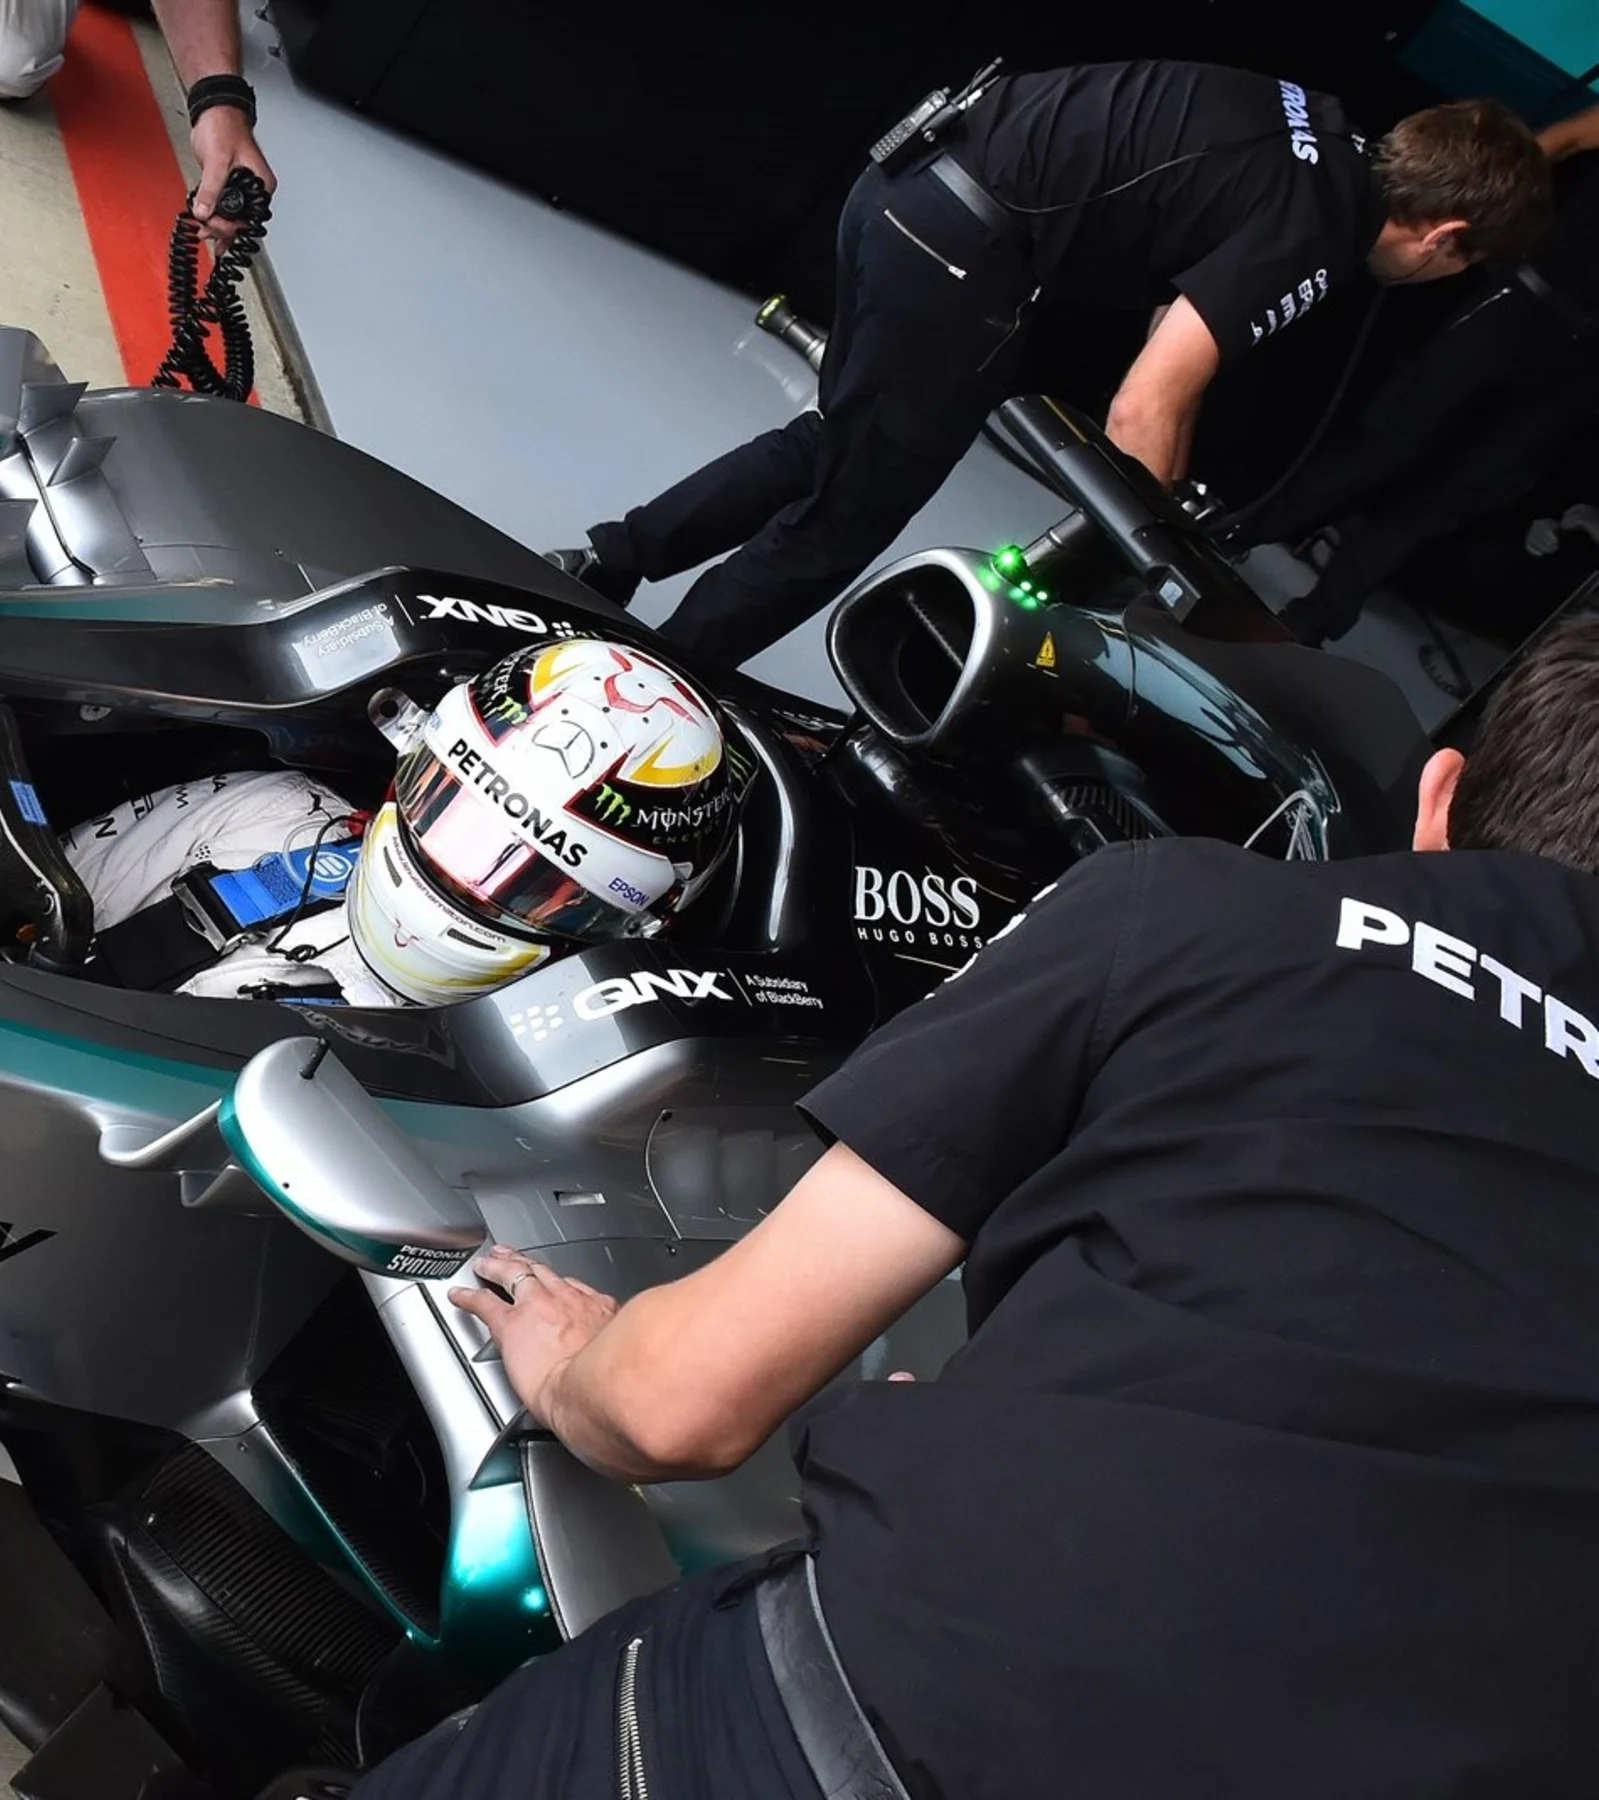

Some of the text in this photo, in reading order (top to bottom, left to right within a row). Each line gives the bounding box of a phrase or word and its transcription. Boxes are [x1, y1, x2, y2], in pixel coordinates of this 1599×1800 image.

[304, 608, 373, 648] BlackBerry
[416, 595, 548, 634] QNX
[318, 620, 385, 657] Subsidiary
[447, 738, 588, 868] PETRONAS
[608, 877, 650, 907] EPSON
[853, 866, 980, 929] BOSS
[857, 927, 983, 949] HUGO BOSS
[572, 969, 734, 1022] QNX
[1336, 897, 1599, 1080] PETR
[400, 1244, 469, 1259] PETRONAS
